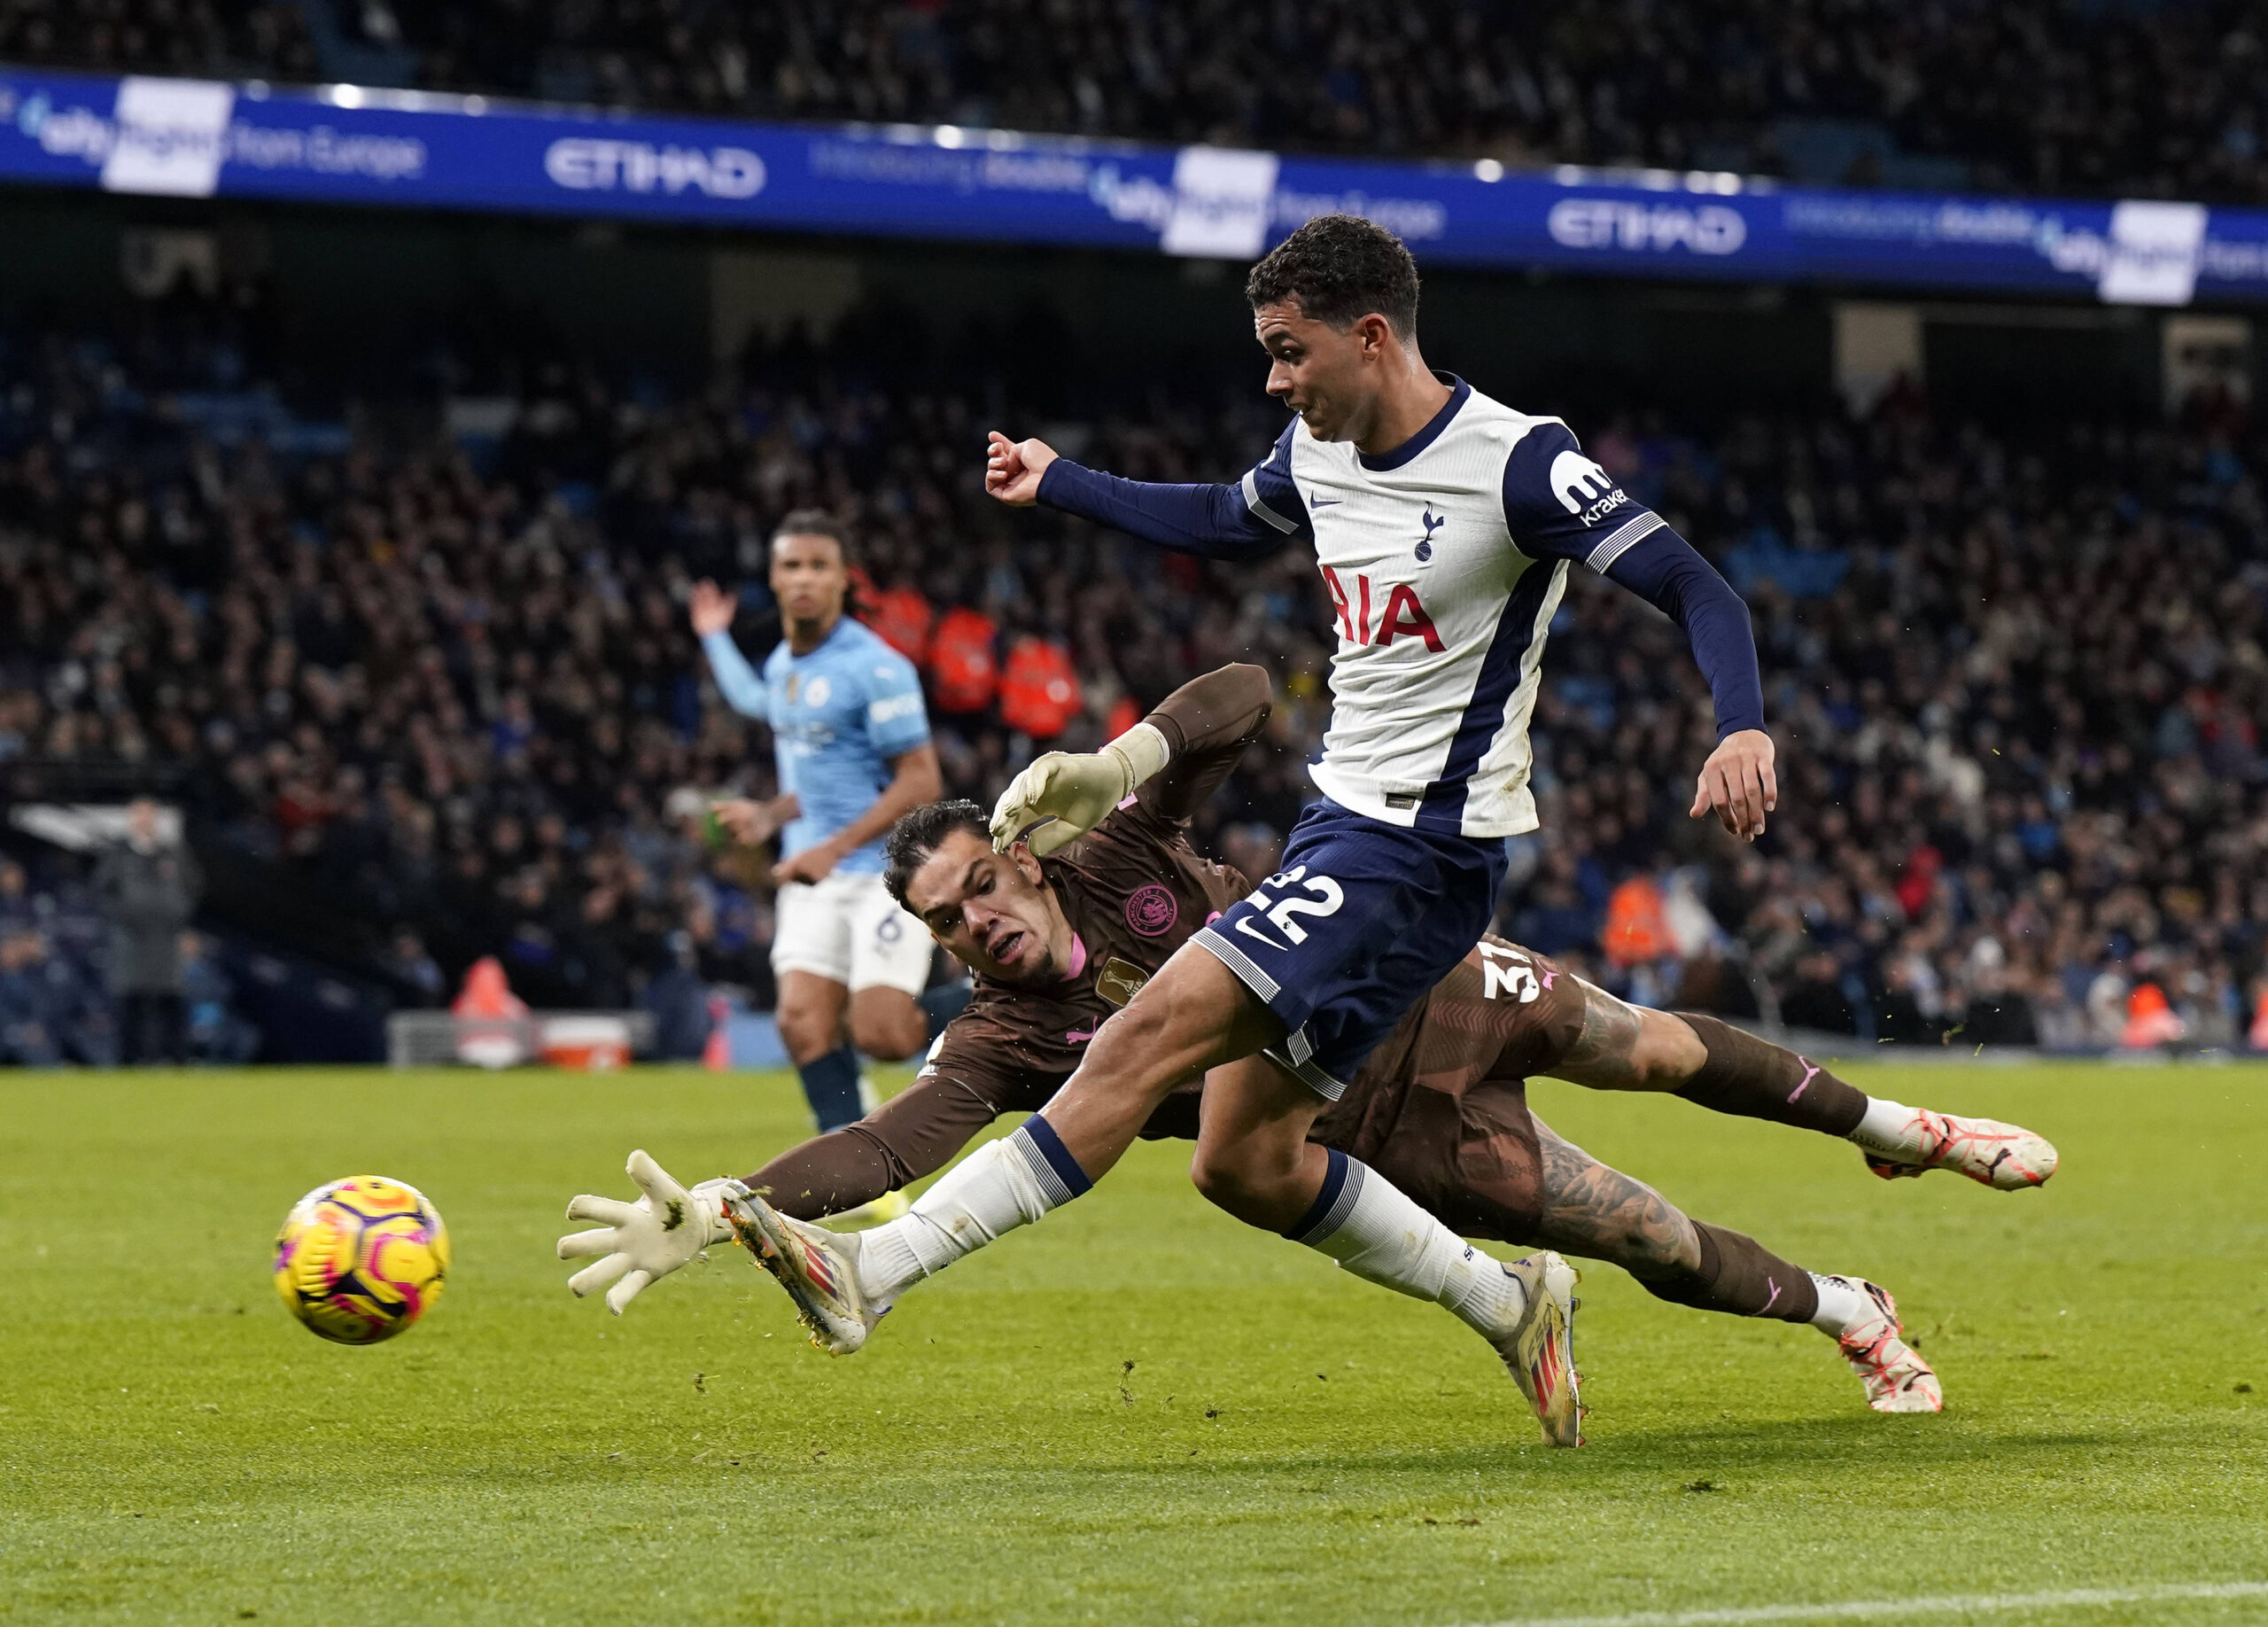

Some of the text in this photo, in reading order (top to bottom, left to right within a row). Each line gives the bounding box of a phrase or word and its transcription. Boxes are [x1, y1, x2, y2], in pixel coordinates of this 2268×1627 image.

[307, 124, 427, 178] Europe
[544, 136, 766, 199] ETIHAD
[1548, 198, 1746, 255] ETIHAD
[1323, 565, 1447, 653] AIA
[876, 907, 903, 943] 6
[1245, 865, 1344, 946] 22
[1477, 941, 1540, 1003] 31
